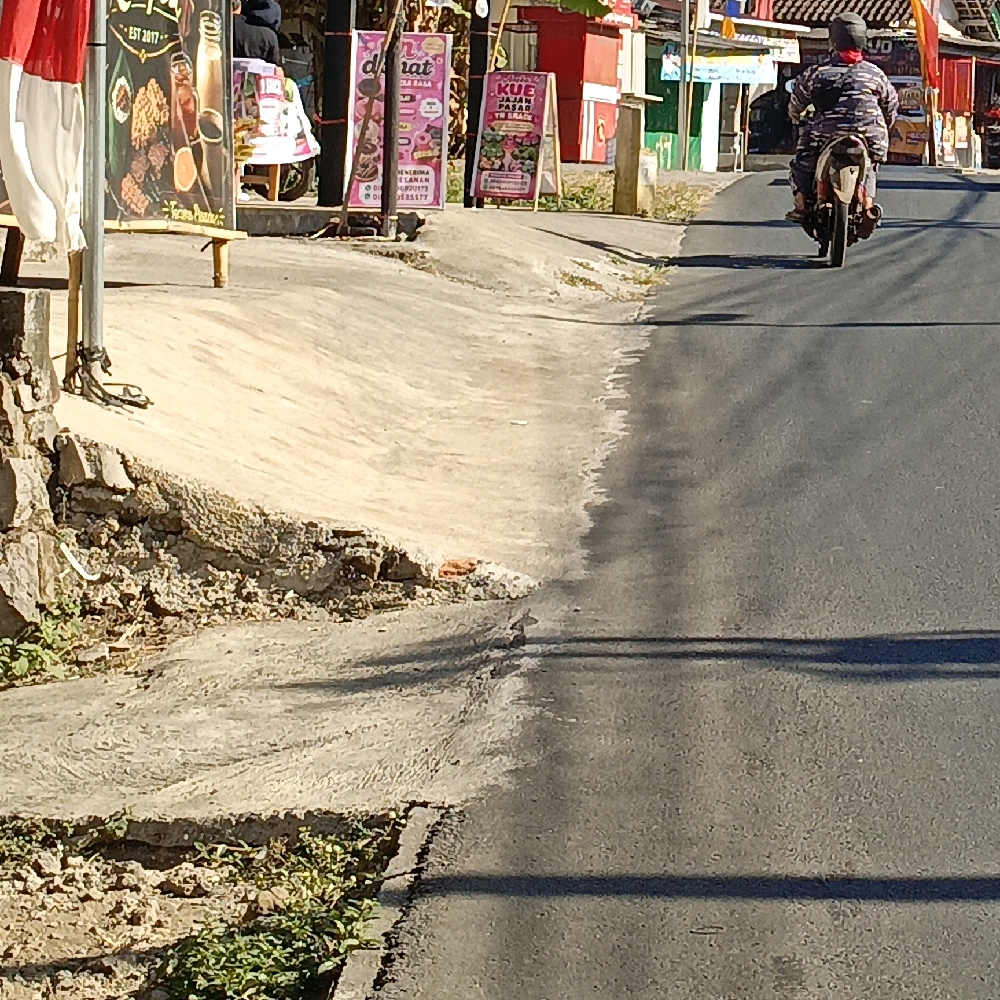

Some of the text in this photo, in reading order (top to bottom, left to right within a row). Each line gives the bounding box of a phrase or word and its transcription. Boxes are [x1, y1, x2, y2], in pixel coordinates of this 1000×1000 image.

[129, 26, 160, 45] EST 2017
[497, 82, 536, 97] KUE
[498, 96, 532, 105] JAJAN
